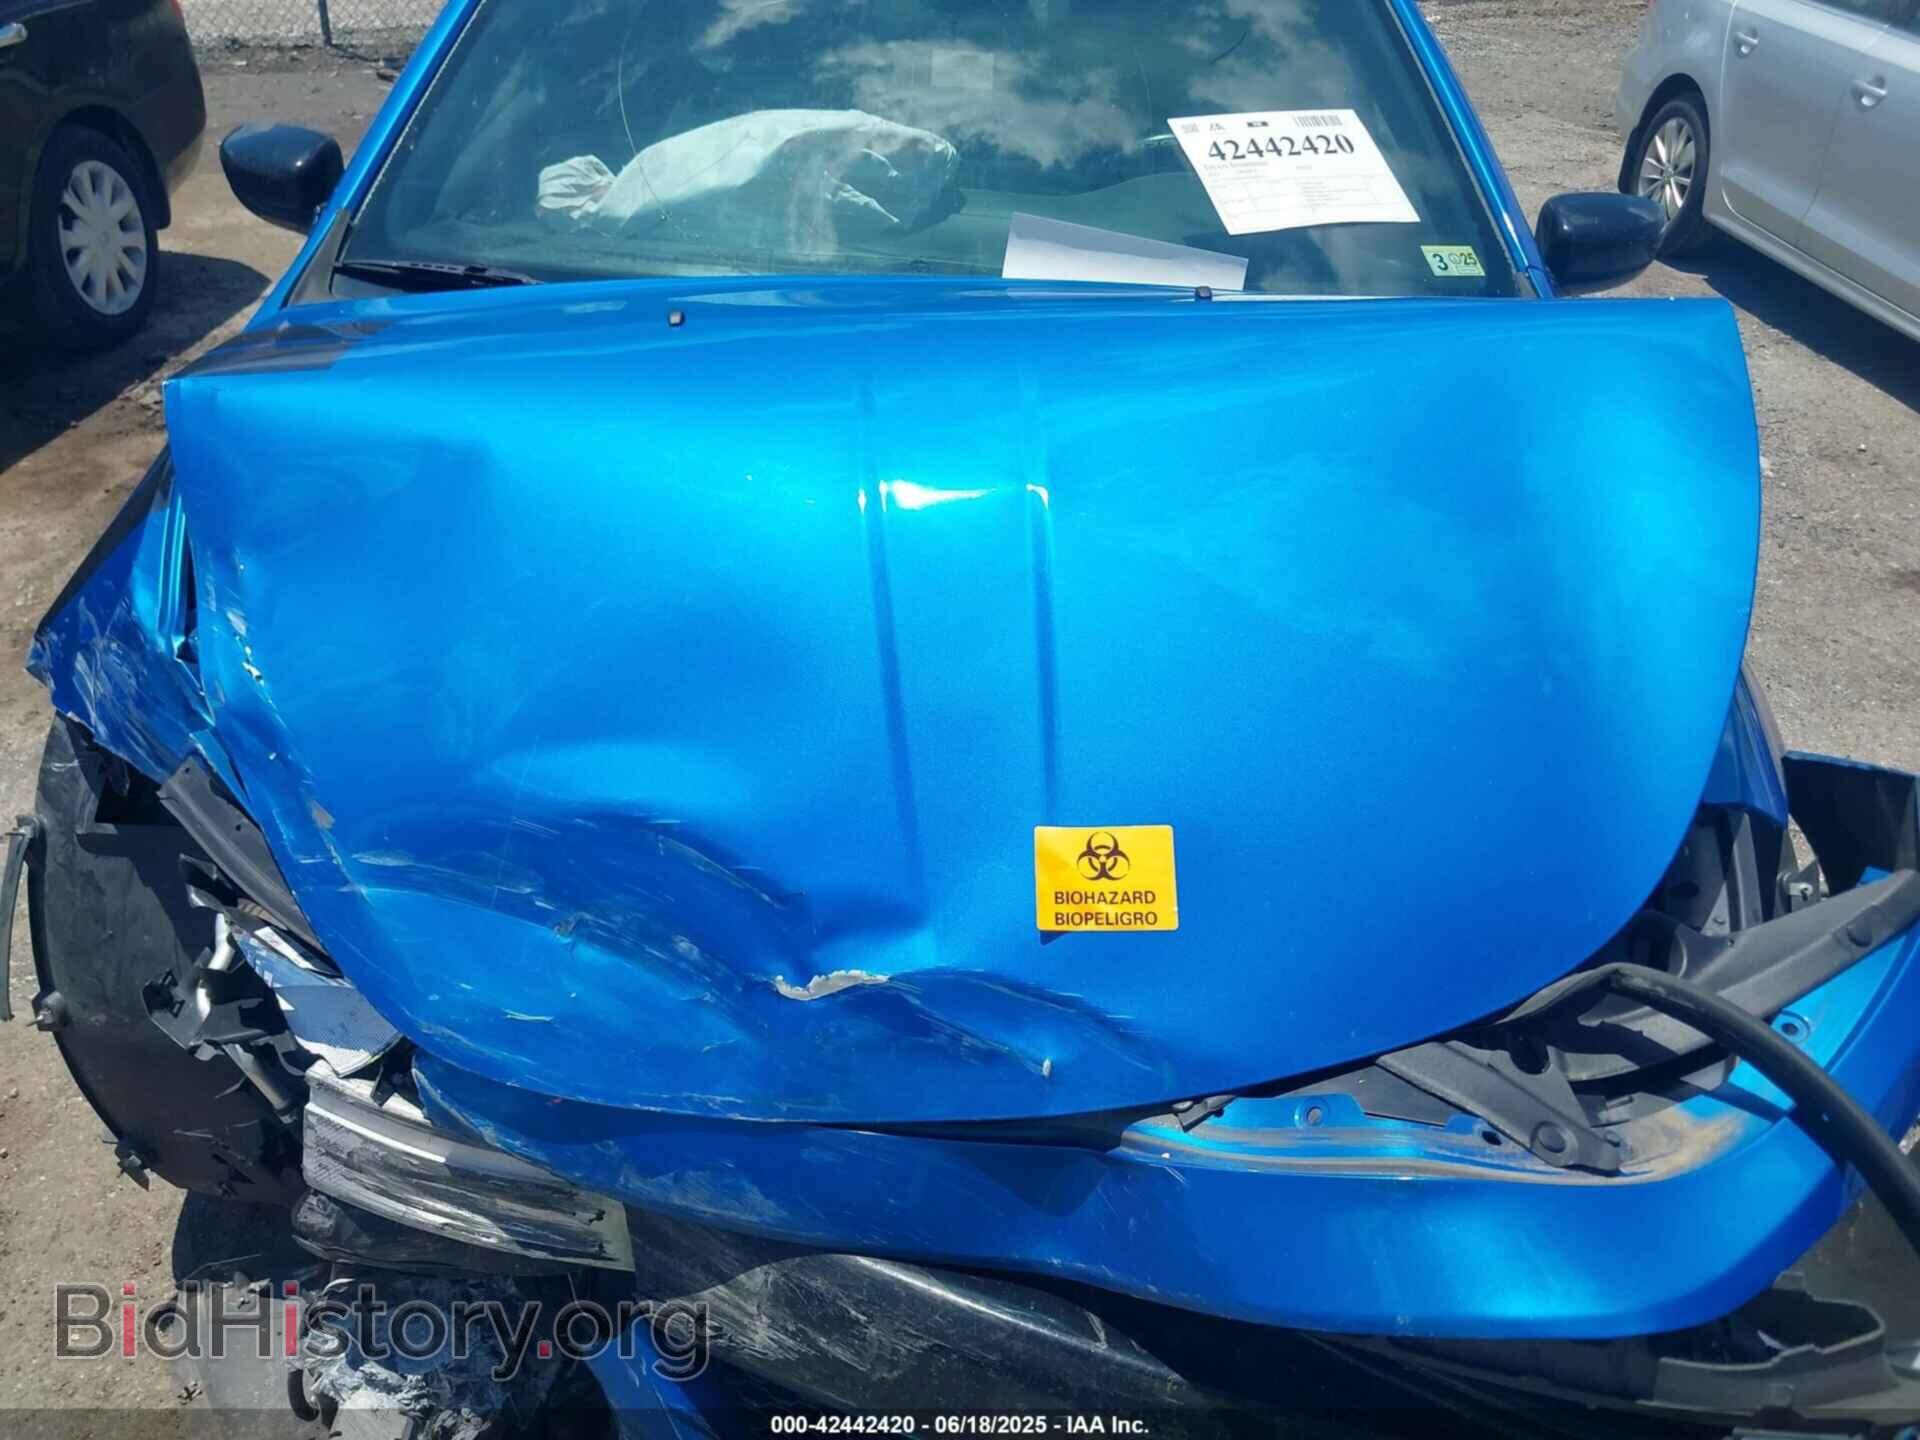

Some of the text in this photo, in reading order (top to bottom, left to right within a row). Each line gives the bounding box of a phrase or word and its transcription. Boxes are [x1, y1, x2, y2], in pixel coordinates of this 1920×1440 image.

[1208, 134, 1355, 160] 42442420
[1432, 252, 1478, 271] 3 25
[1054, 890, 1157, 905] BIOHAZARD
[1054, 911, 1159, 926] BIOPELIGRO
